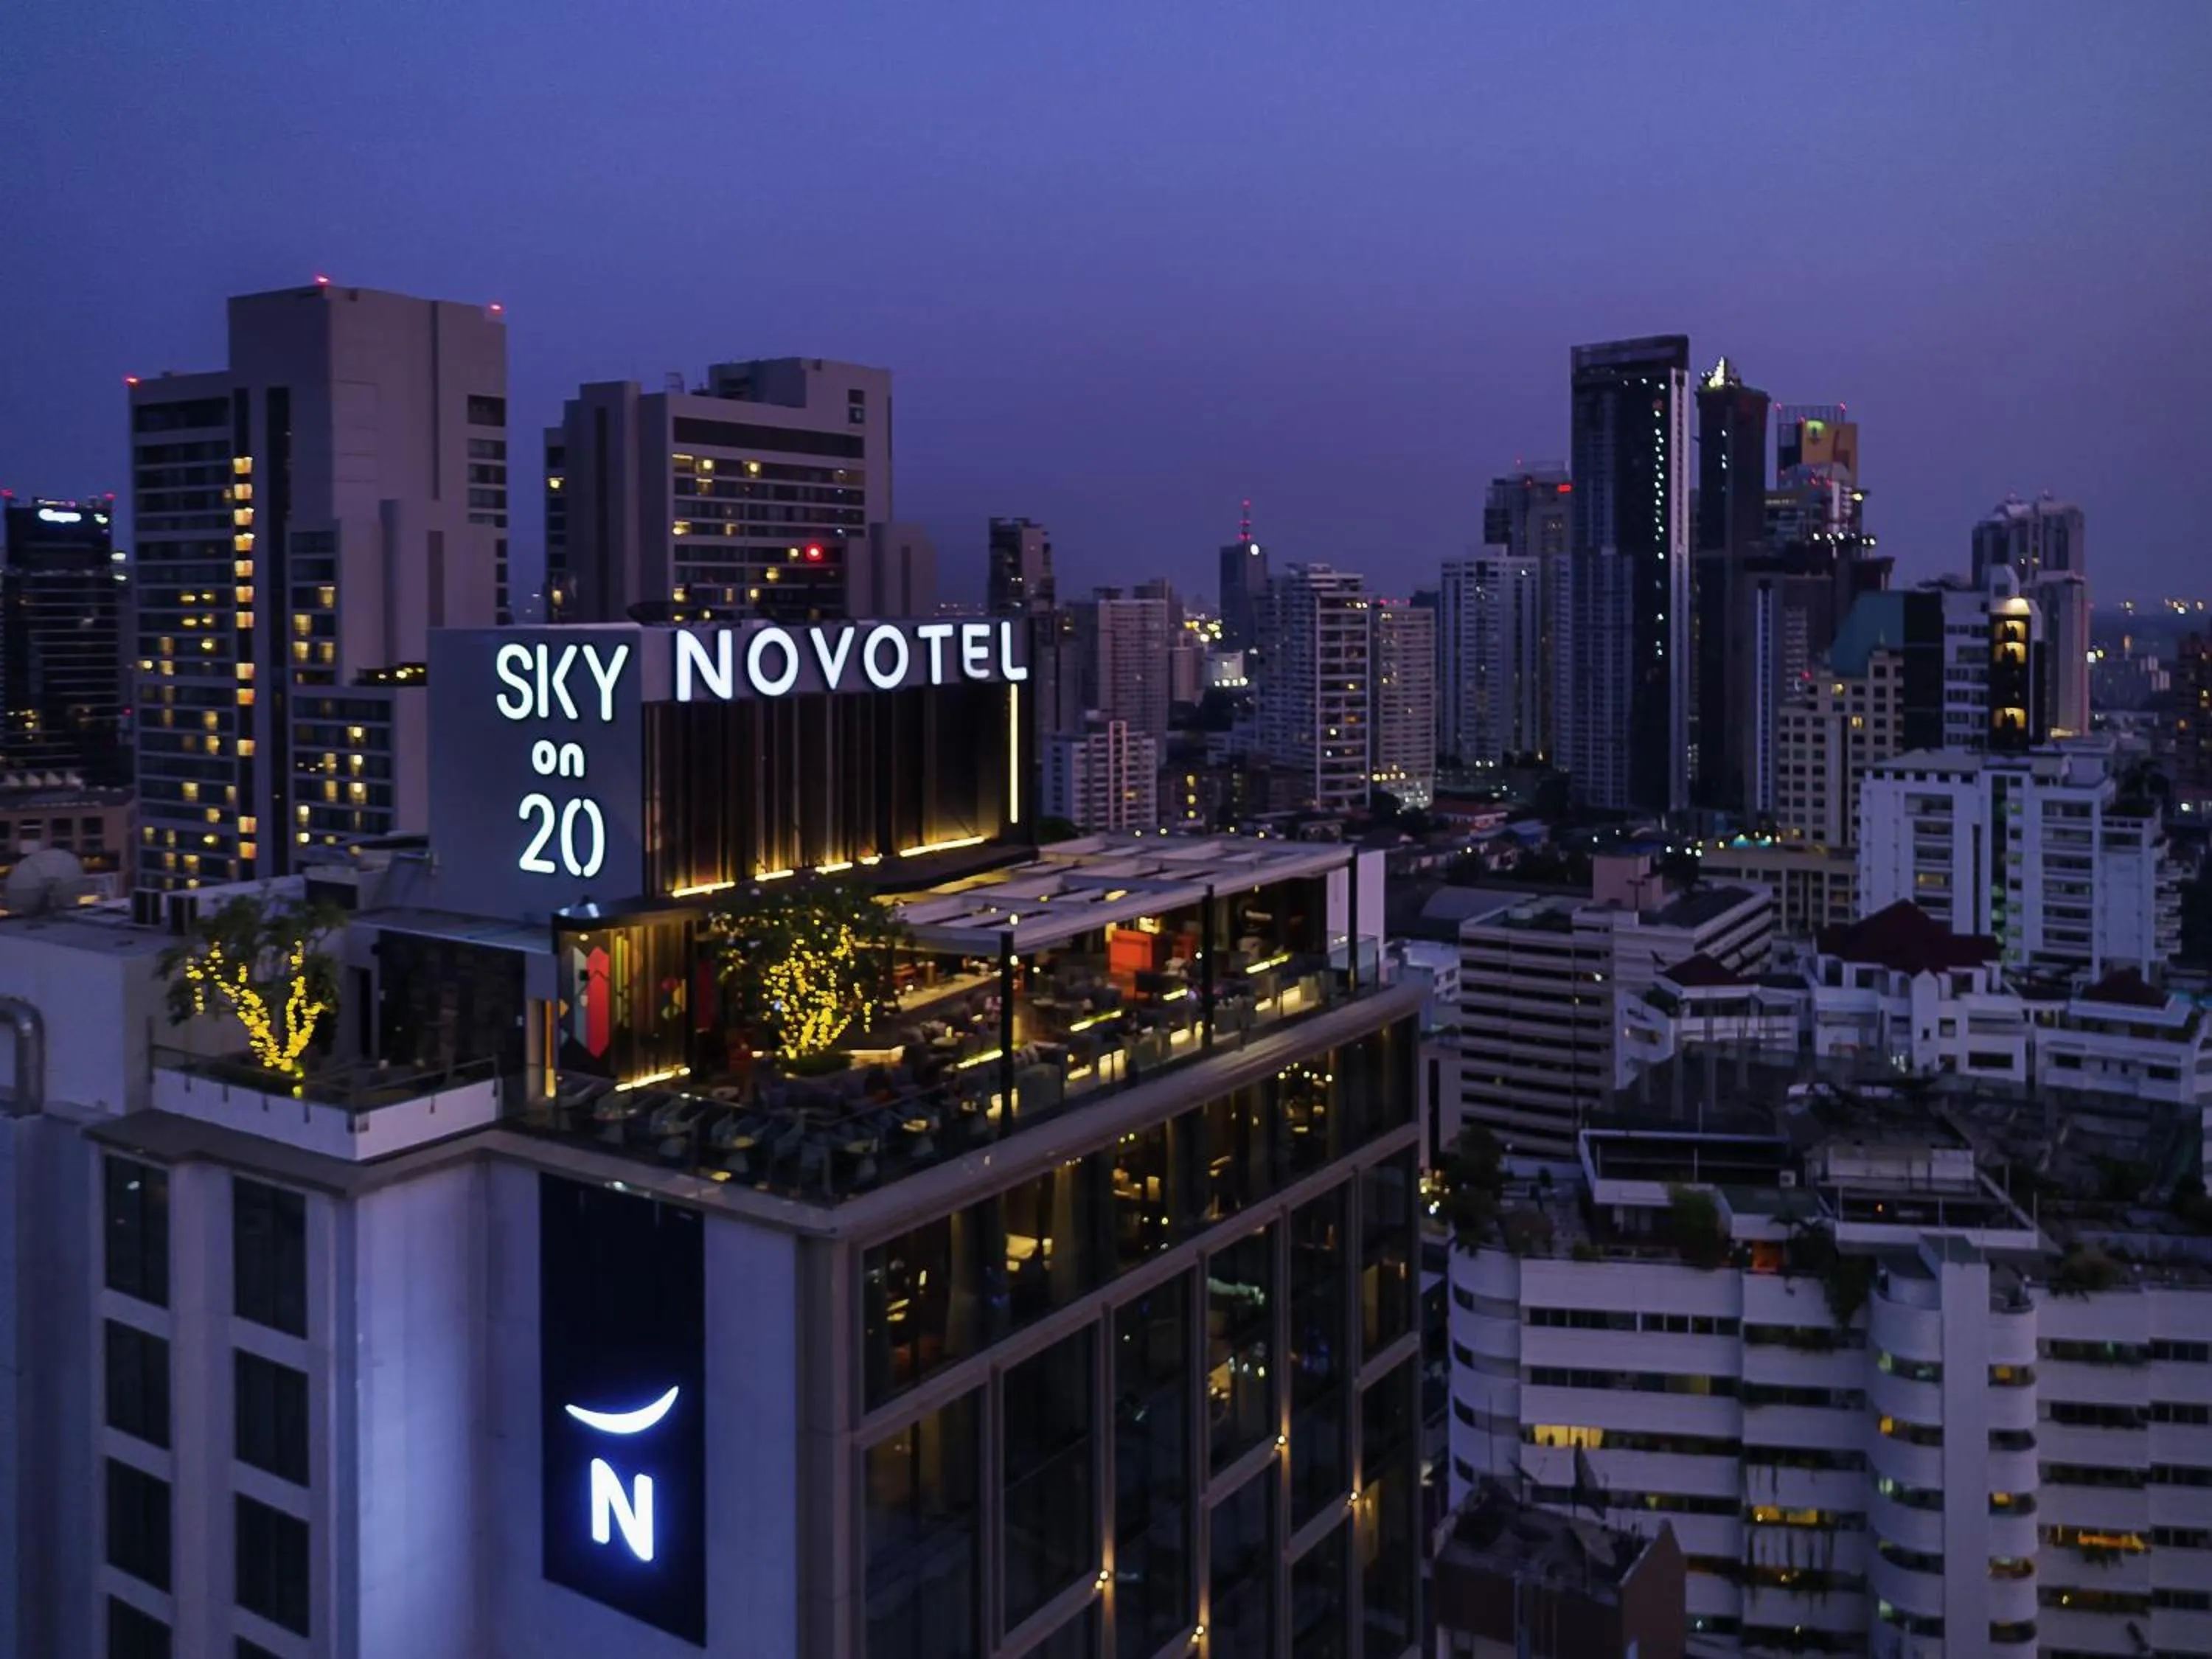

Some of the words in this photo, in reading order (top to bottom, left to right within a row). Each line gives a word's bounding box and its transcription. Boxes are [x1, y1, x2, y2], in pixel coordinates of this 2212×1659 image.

[496, 644, 629, 721] SKY
[677, 621, 1027, 702] NOVOTEL
[532, 740, 584, 777] on
[518, 793, 605, 877] 20
[591, 1458, 654, 1562] N
